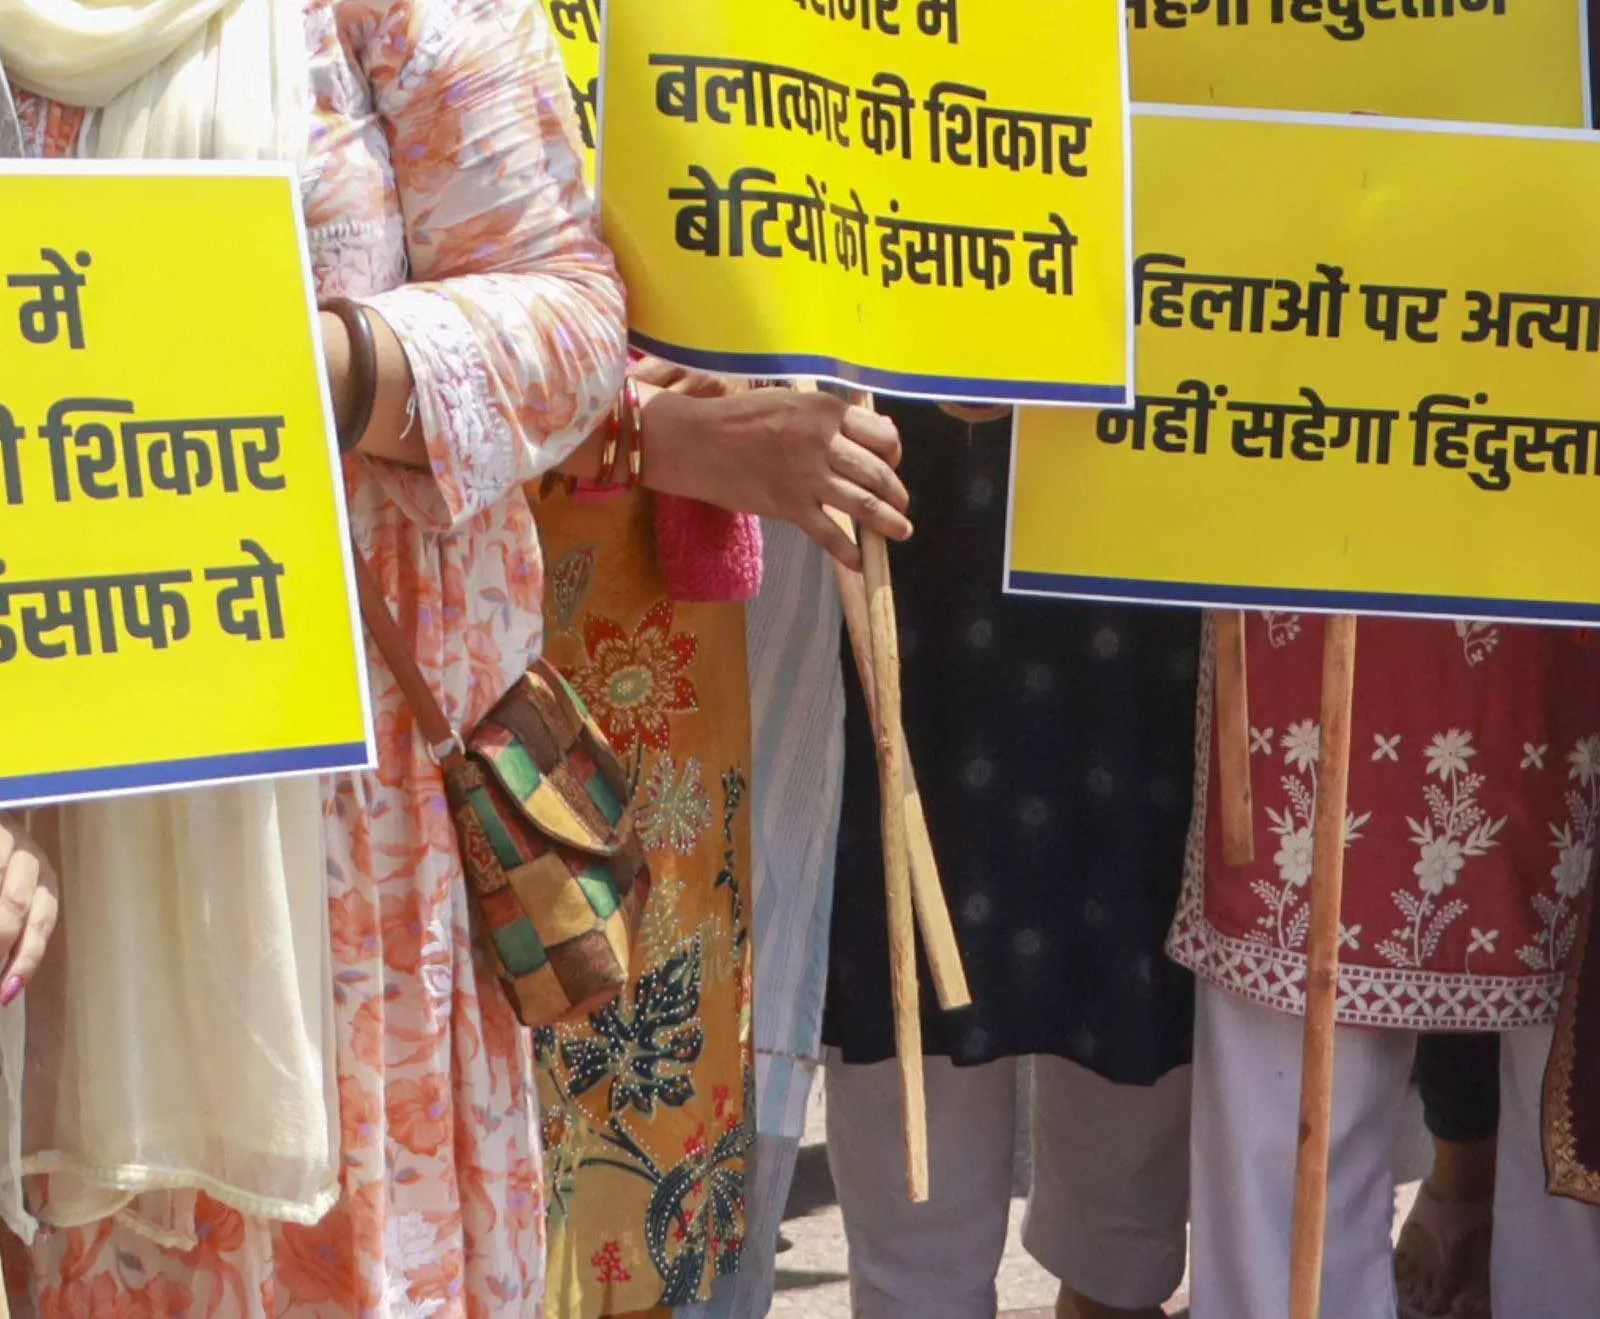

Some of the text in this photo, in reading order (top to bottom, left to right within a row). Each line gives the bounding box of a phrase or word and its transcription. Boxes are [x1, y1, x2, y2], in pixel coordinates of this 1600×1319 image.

[648, 53, 850, 147] बलात्कार
[856, 73, 915, 159] की
[923, 82, 1092, 177] शिकार
[668, 165, 1078, 295] बेटियों को इंसाफ दो
[7, 248, 91, 349] में
[1133, 253, 1350, 338] हिलाओं
[1360, 285, 1447, 343] पर
[38, 398, 285, 502] शिकार
[1096, 379, 1227, 454] नहीं
[1227, 387, 1399, 464] सहेगा
[204, 539, 284, 640] दो
